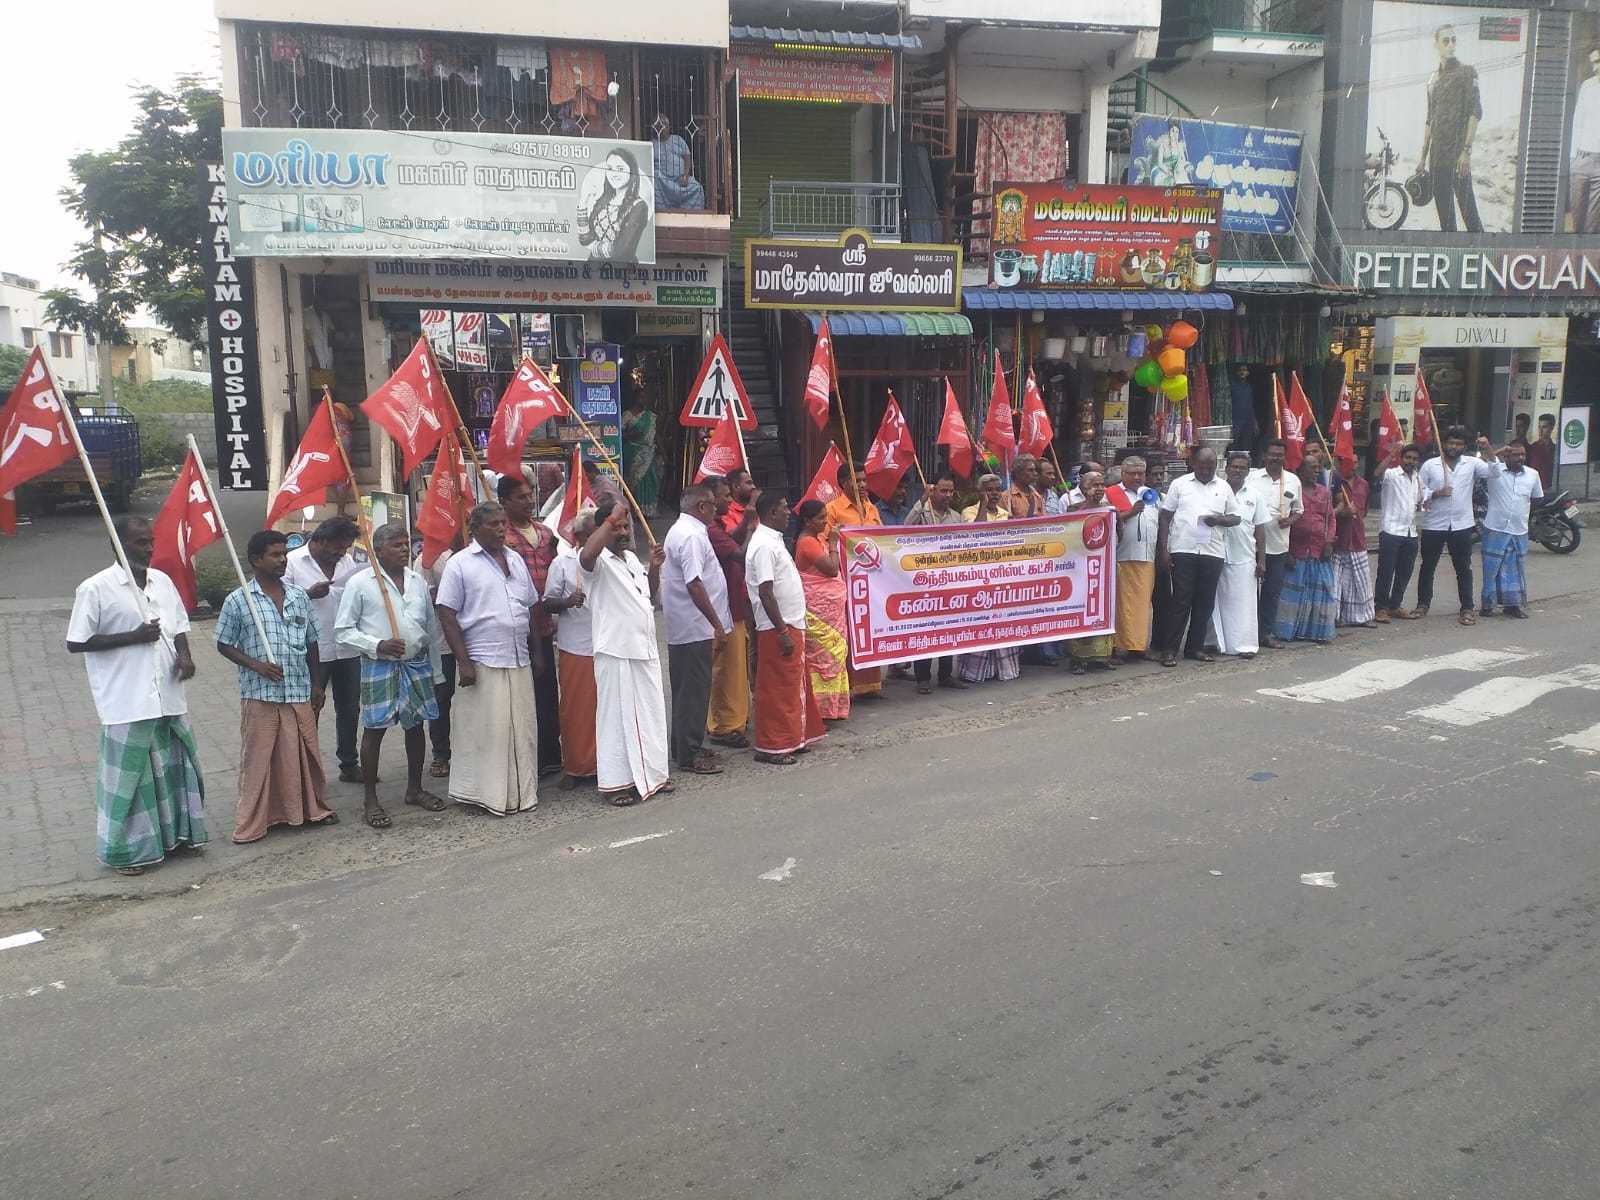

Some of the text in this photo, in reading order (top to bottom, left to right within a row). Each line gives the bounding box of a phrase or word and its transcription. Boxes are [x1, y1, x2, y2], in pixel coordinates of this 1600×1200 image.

[759, 58, 859, 73] MINI PROJECT'S
[743, 87, 874, 101] SALES & SERVICE
[857, 84, 872, 92] UPS
[233, 138, 390, 186] மரியா
[512, 142, 549, 157] 97517
[552, 143, 591, 159] 98150
[398, 161, 577, 191] மகளிர் தையலகம்
[1033, 194, 1217, 224] மகேஸ்வரி மெட்டல் மார்ட்
[207, 164, 243, 302] KAMALAM
[842, 243, 867, 266] ஸ்ரீ
[375, 259, 709, 289] மரியா மகளிர் தையலகம் & பியூட்டி பார்லர்
[755, 264, 865, 299] மாதேஸ்வரா
[1353, 252, 1600, 290] PETER ENGLAN
[377, 285, 443, 299] பெண்களுக்கு
[445, 287, 501, 299] தேவையான
[504, 289, 548, 303] அனைத்து
[551, 290, 604, 302] ஆடைகளும்
[1455, 327, 1507, 344] DIWALI
[220, 337, 252, 488] HOSPITAL
[1028, 559, 1054, 575] கட்சி
[898, 580, 1061, 616] கண்டன ஆர்ப்பாட்டம்
[1088, 559, 1100, 613] CPI
[852, 579, 868, 649] CPI
